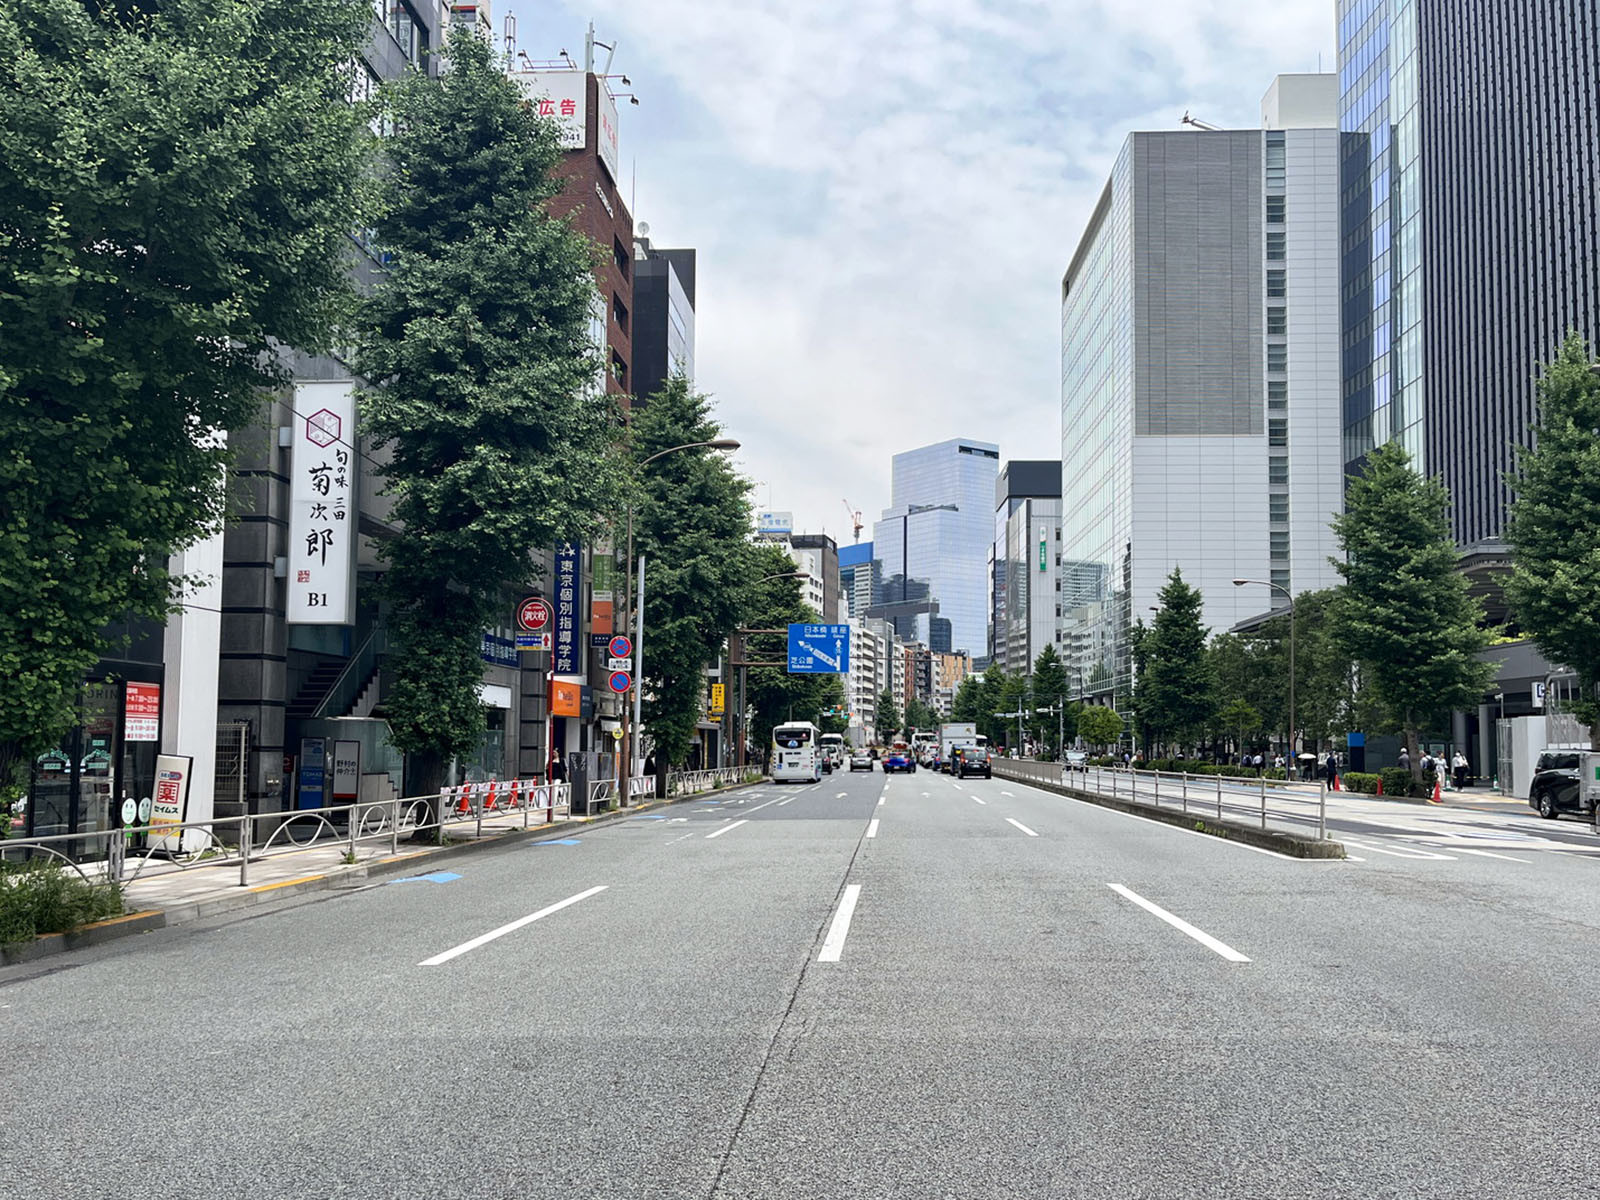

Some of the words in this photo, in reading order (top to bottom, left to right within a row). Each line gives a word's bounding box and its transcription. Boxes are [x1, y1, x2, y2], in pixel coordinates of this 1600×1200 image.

[335, 448, 348, 488] 旬の味
[306, 461, 334, 567] 菊次郎
[333, 497, 346, 520] 三田
[307, 592, 329, 607] B1
[524, 610, 546, 622] 消火栓
[557, 560, 575, 672] 東京個別指導学院
[804, 625, 827, 633] 日本橋
[791, 656, 814, 664] 芝公園
[337, 760, 357, 768] 野村の
[159, 783, 177, 801] 薬
[154, 805, 179, 814] セイムス
